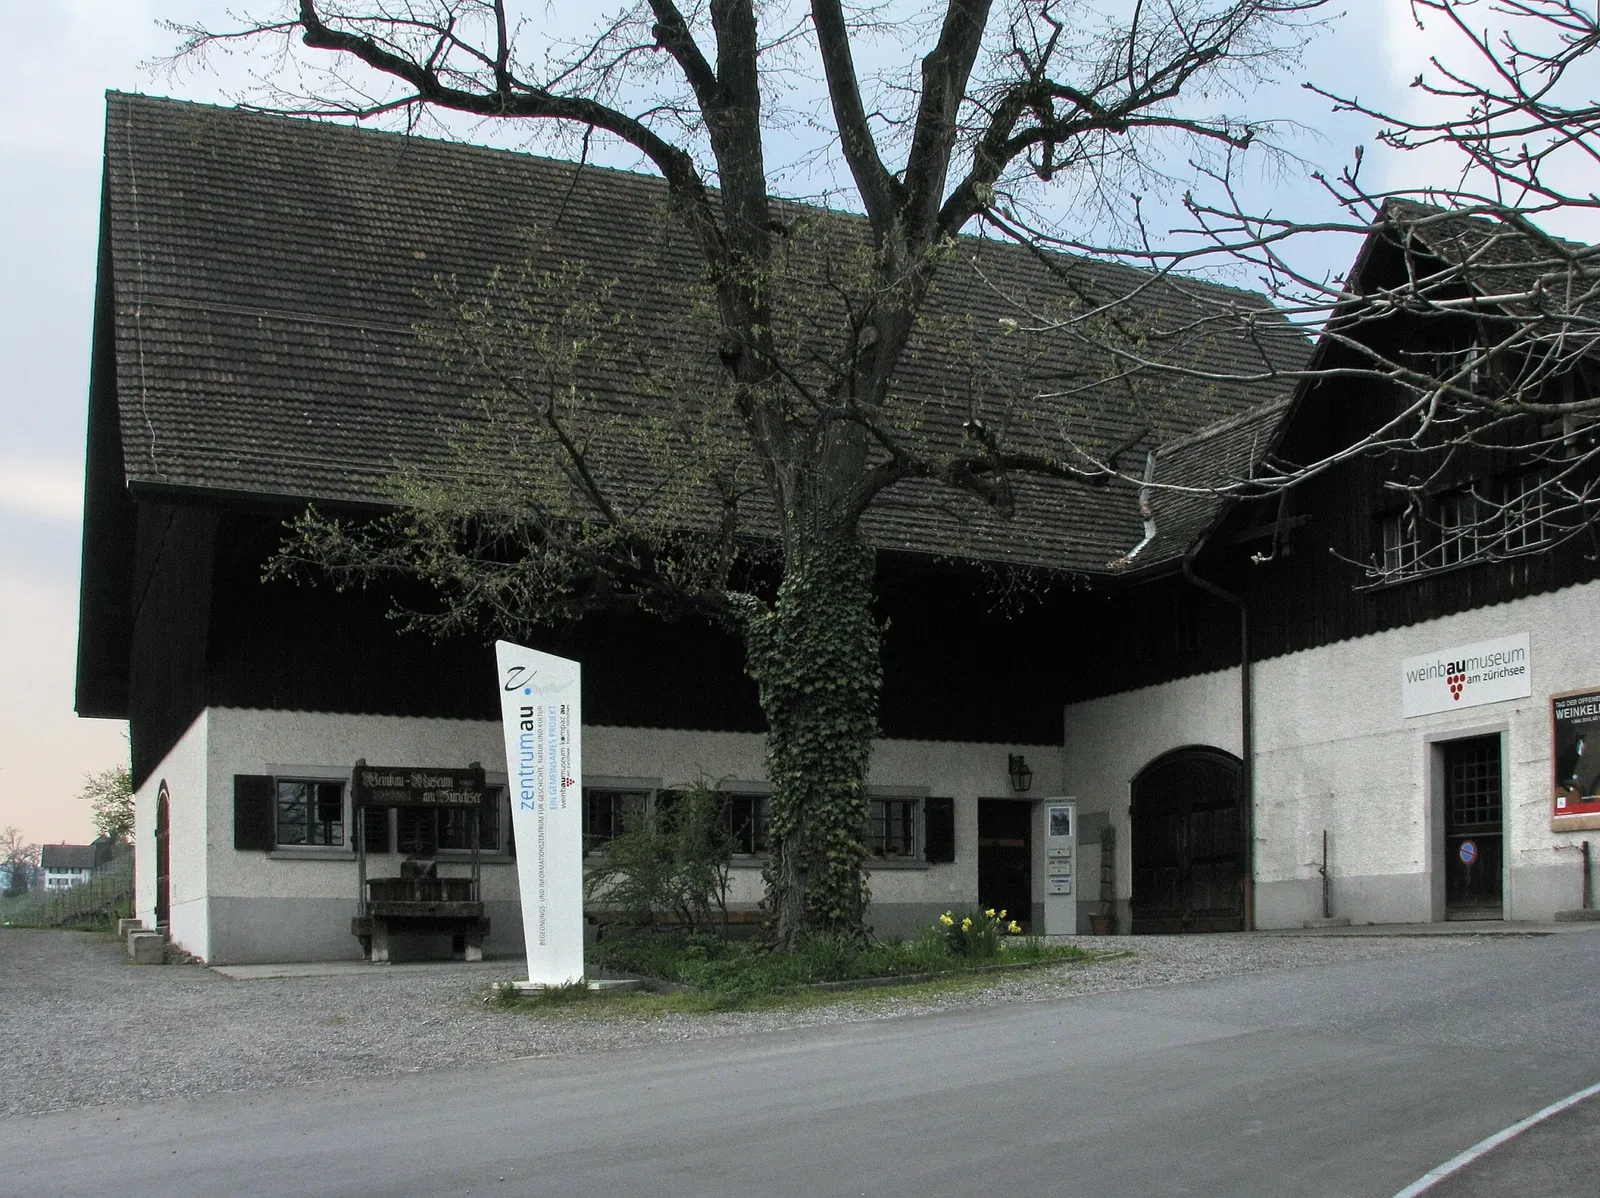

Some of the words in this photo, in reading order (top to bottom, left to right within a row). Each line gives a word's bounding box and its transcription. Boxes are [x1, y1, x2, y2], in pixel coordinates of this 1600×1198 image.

[1406, 648, 1525, 683] weinbaumuseum
[1466, 674, 1481, 685] am
[1483, 665, 1525, 682] zürichsee
[1555, 703, 1600, 720] WEINKEL
[1566, 698, 1577, 707] DER
[548, 704, 557, 738] PROJEKT
[518, 706, 535, 811] zentrumau
[548, 738, 557, 796] GEMEINSAMES
[549, 797, 557, 810] EIN
